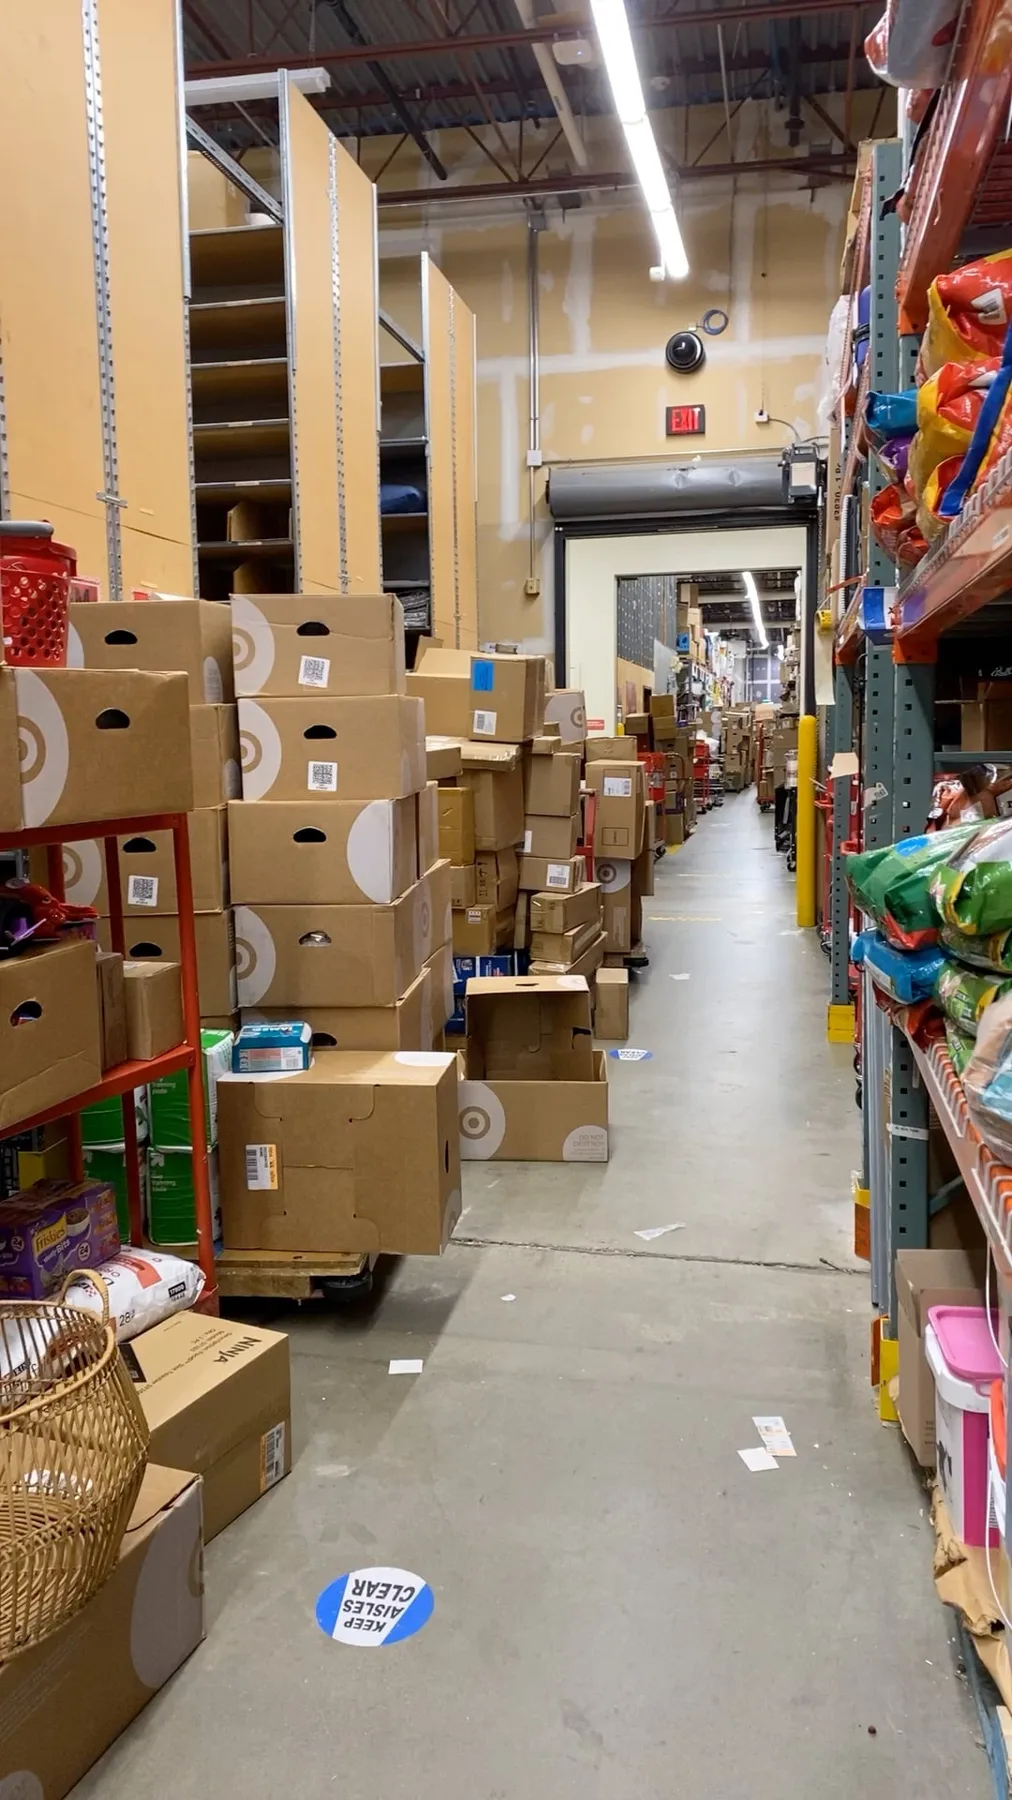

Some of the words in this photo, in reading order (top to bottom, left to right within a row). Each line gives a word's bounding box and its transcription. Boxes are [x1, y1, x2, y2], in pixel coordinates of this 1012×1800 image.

[671, 407, 701, 431] EXIT
[79, 1244, 89, 1254] 24
[119, 1311, 131, 1327] 28
[213, 1336, 263, 1363] NINJA
[351, 1579, 416, 1603] CLEAR
[342, 1599, 405, 1619] AISLES
[343, 1616, 387, 1633] KEEP
